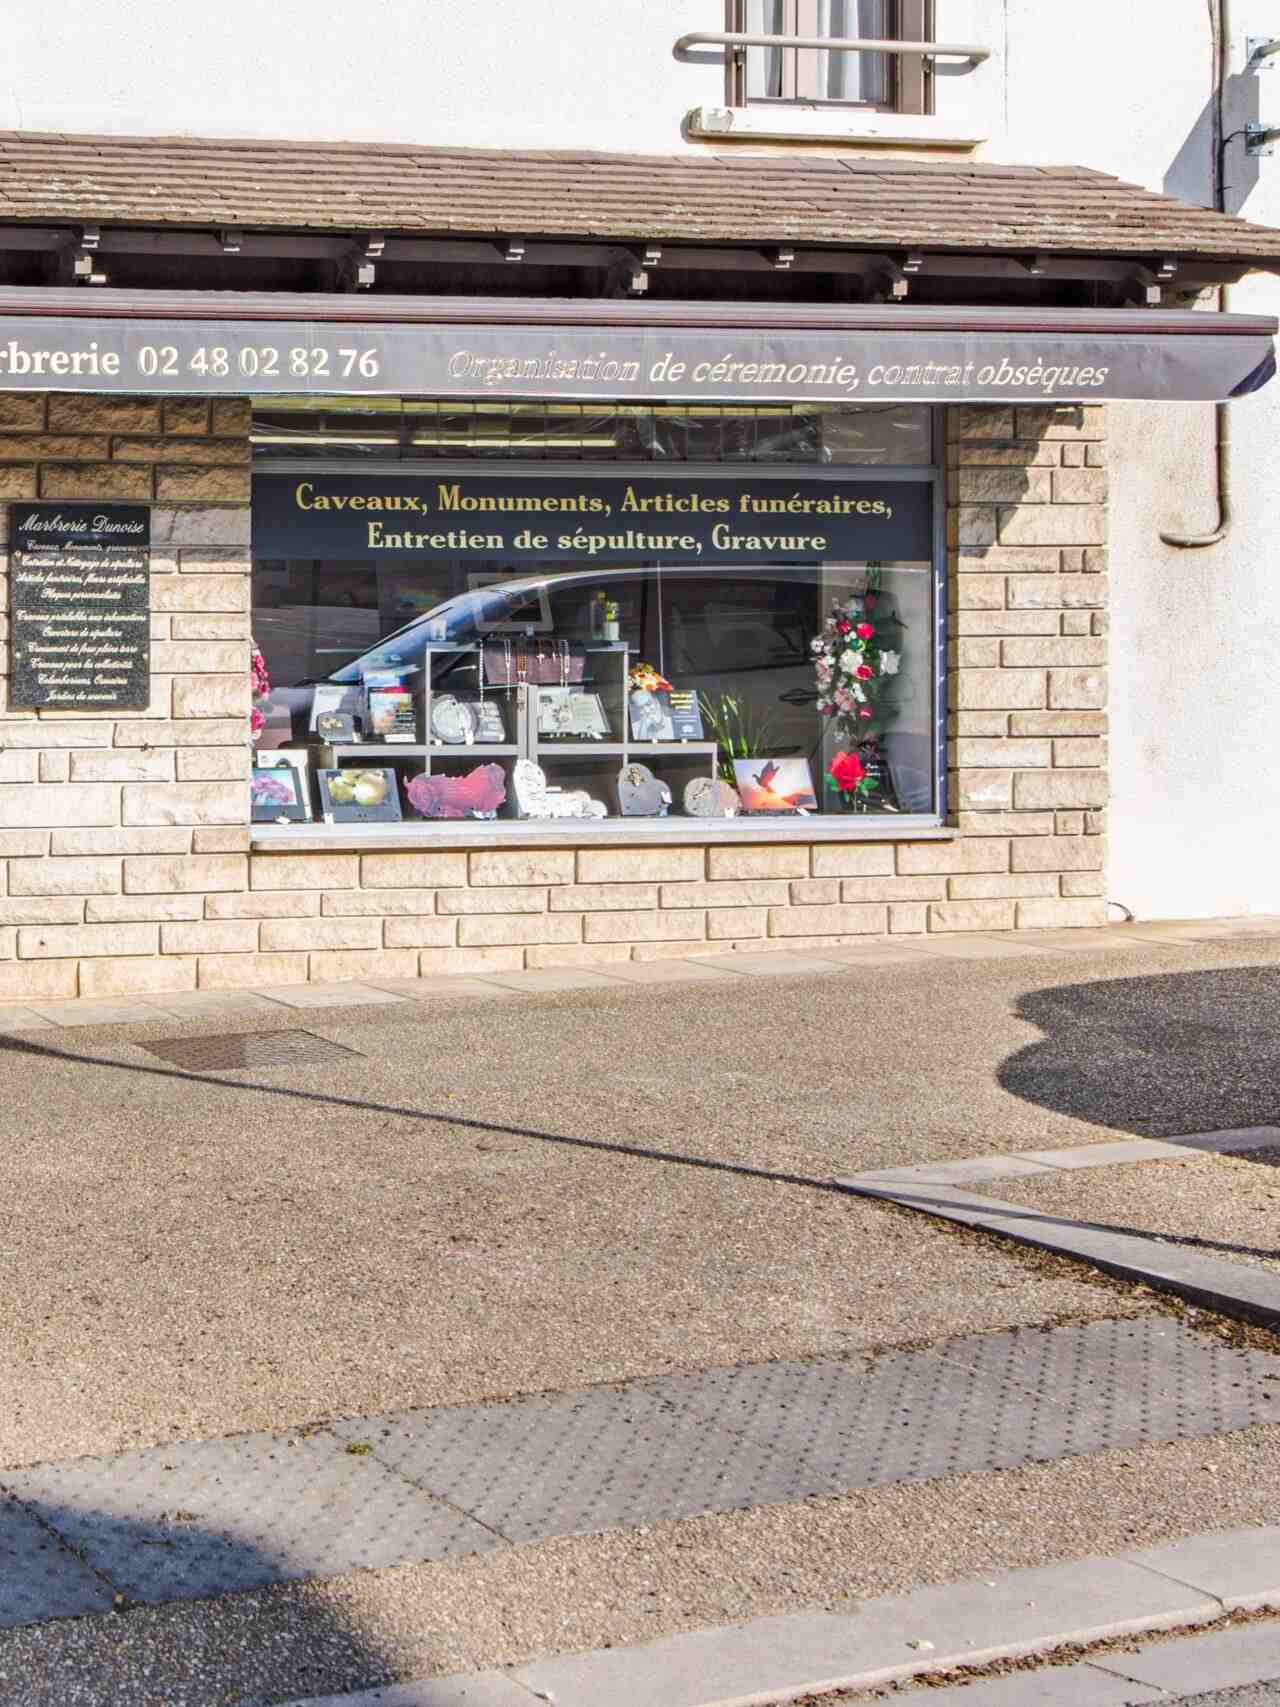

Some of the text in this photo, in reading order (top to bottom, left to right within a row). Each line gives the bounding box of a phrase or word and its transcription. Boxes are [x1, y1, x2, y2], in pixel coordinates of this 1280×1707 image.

[138, 345, 179, 376] 02
[190, 346, 229, 376] 48
[240, 347, 280, 376] 02
[288, 348, 330, 377] 82
[339, 348, 379, 378] 76
[448, 350, 639, 385] Organisation
[649, 353, 686, 382] de
[867, 358, 975, 385] contrat
[977, 357, 1110, 394] obsèques
[295, 484, 894, 518] Caveaux, Monuments, Articles funéraires,
[19, 513, 144, 534] Marbrerie Dunoise
[367, 522, 827, 556] Entretien de sépulture, Gravure
